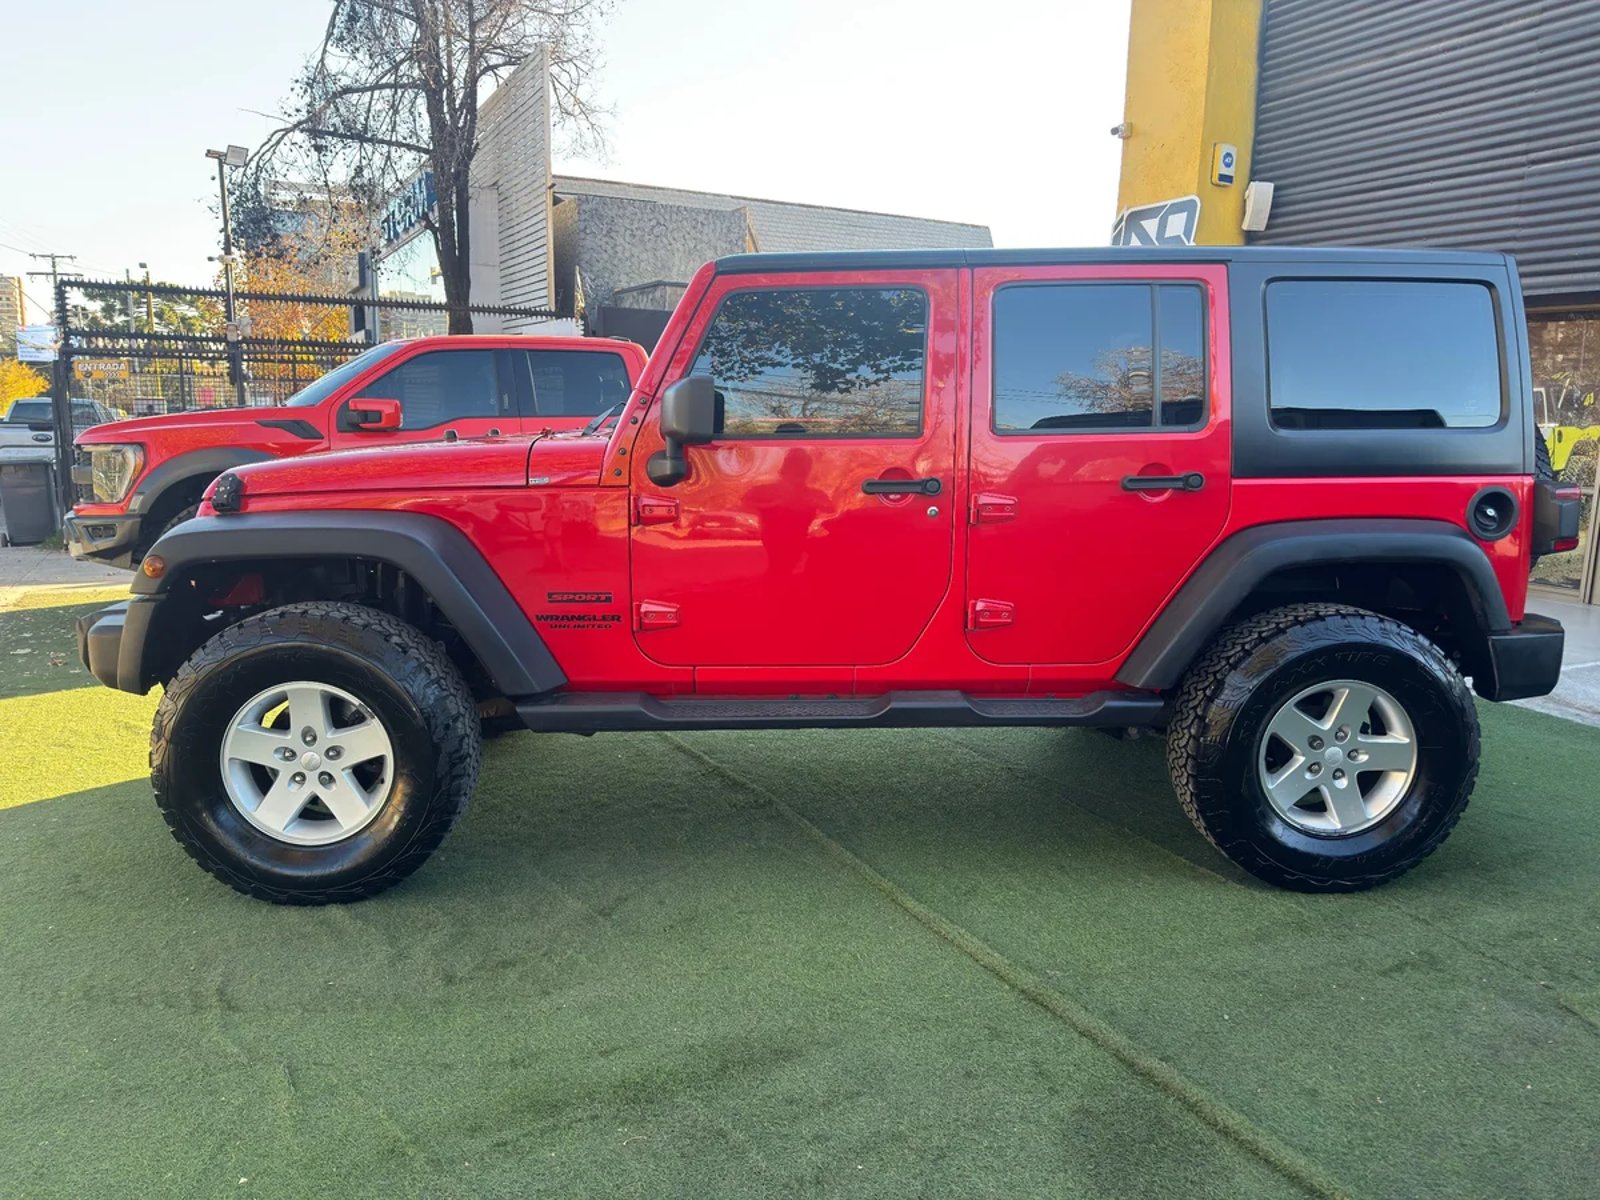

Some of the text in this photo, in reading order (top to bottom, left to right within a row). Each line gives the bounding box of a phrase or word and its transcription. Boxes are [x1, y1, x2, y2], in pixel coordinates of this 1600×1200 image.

[78, 363, 126, 371] ENTRADA
[549, 592, 614, 602] SPORT
[535, 614, 622, 623] WRANGLER
